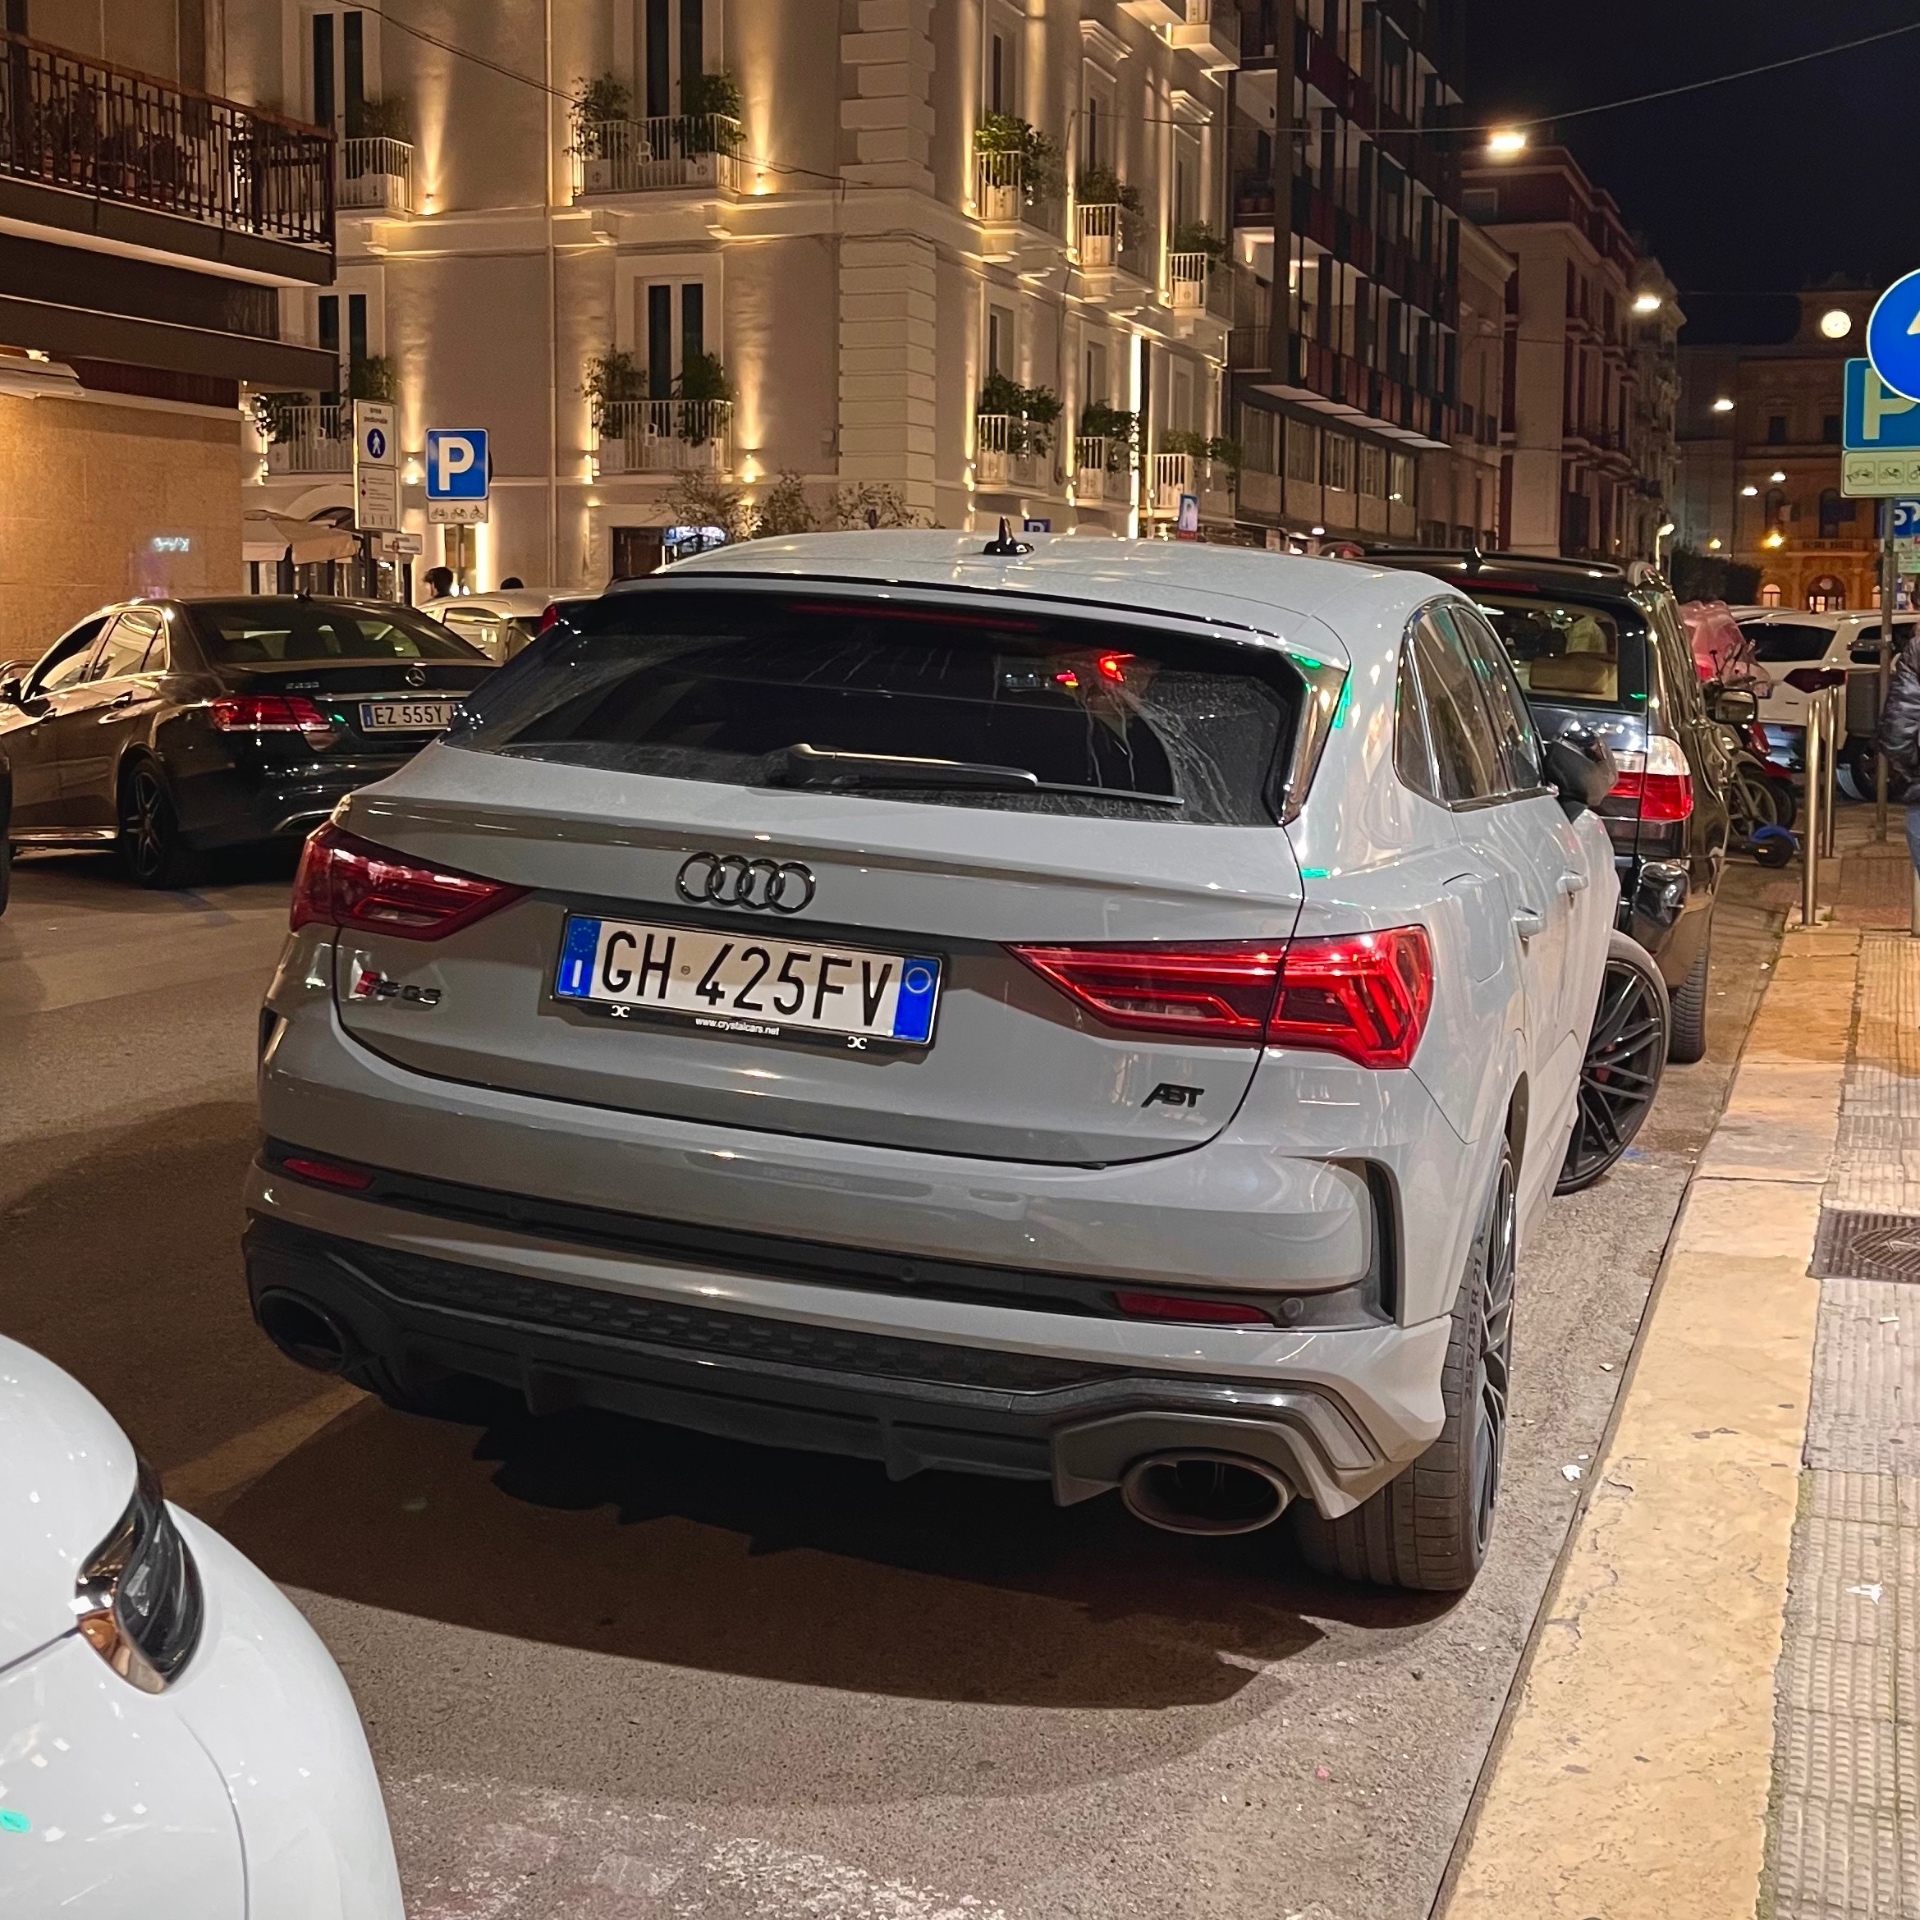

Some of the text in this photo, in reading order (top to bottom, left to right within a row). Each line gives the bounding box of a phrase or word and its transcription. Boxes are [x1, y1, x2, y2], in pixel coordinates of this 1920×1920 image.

[439, 437, 475, 490] P
[374, 706, 397, 724] EZ
[602, 930, 892, 1026] GH 425FV
[695, 1018, 780, 1035] www.crystalcars.net
[1141, 1083, 1205, 1108] ABT
